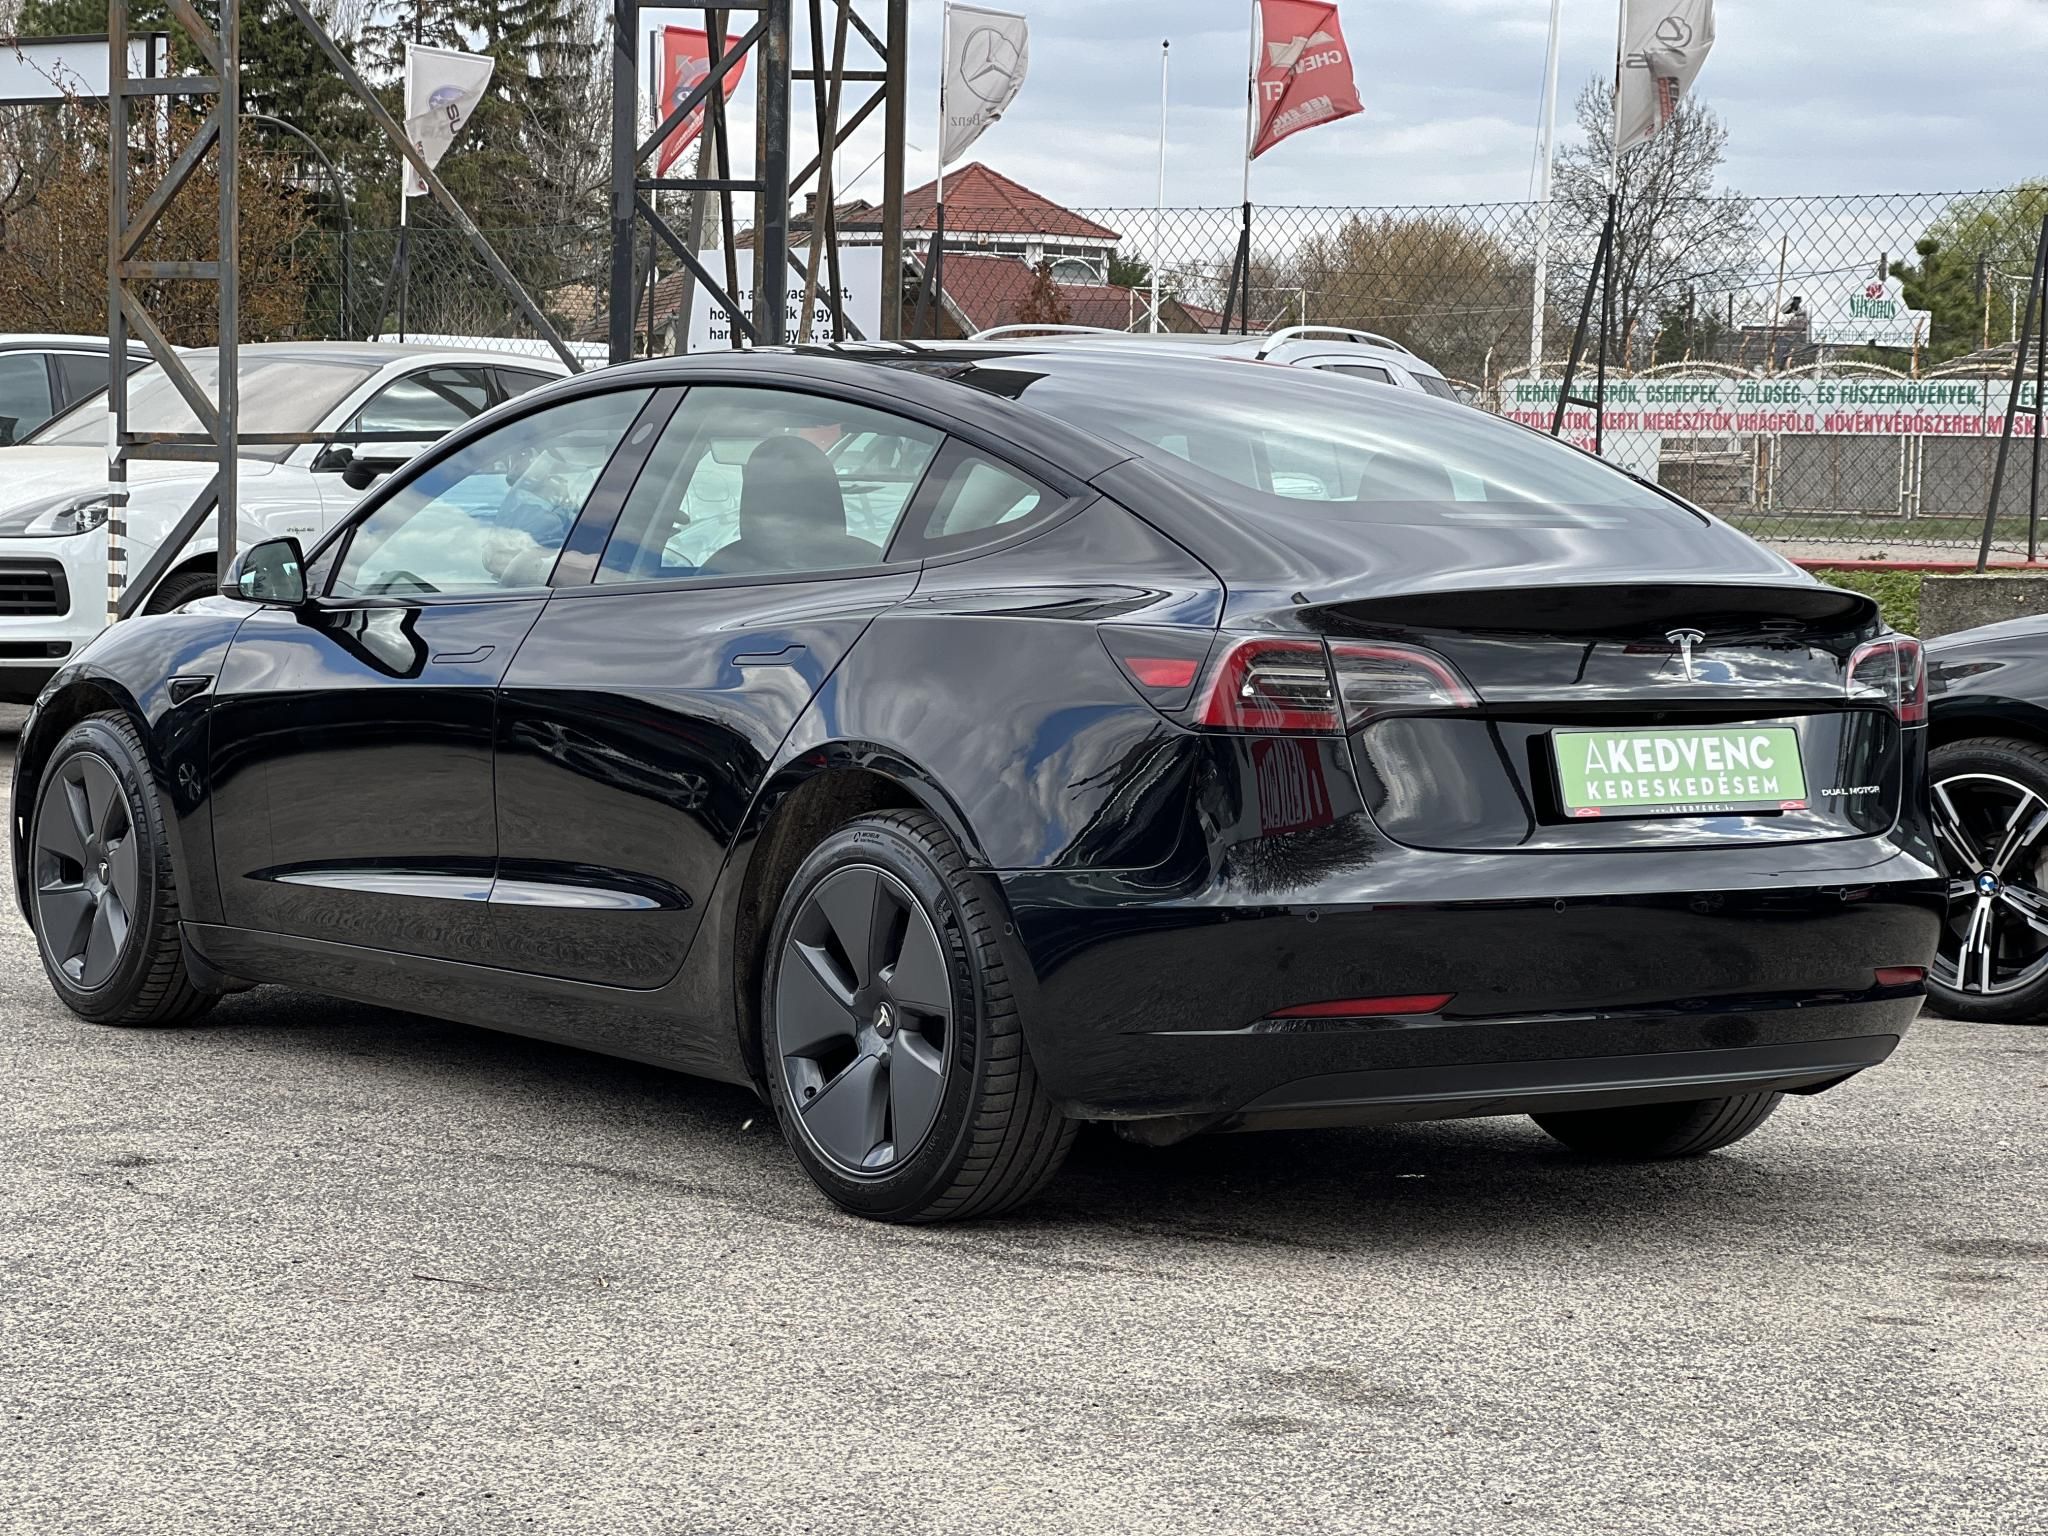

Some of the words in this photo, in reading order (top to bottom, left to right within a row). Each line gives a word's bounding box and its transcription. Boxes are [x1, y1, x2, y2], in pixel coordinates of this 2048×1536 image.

[1817, 381, 1836, 404] ÉS
[1601, 412, 1638, 430] KERTI
[1824, 408, 1982, 433] NÖVÉNYVÉDŐSZEREK
[1586, 771, 1780, 800] KERESKEDÉSEM
[1822, 788, 1848, 796] DUAL
[1849, 785, 1881, 795] MOTOR
